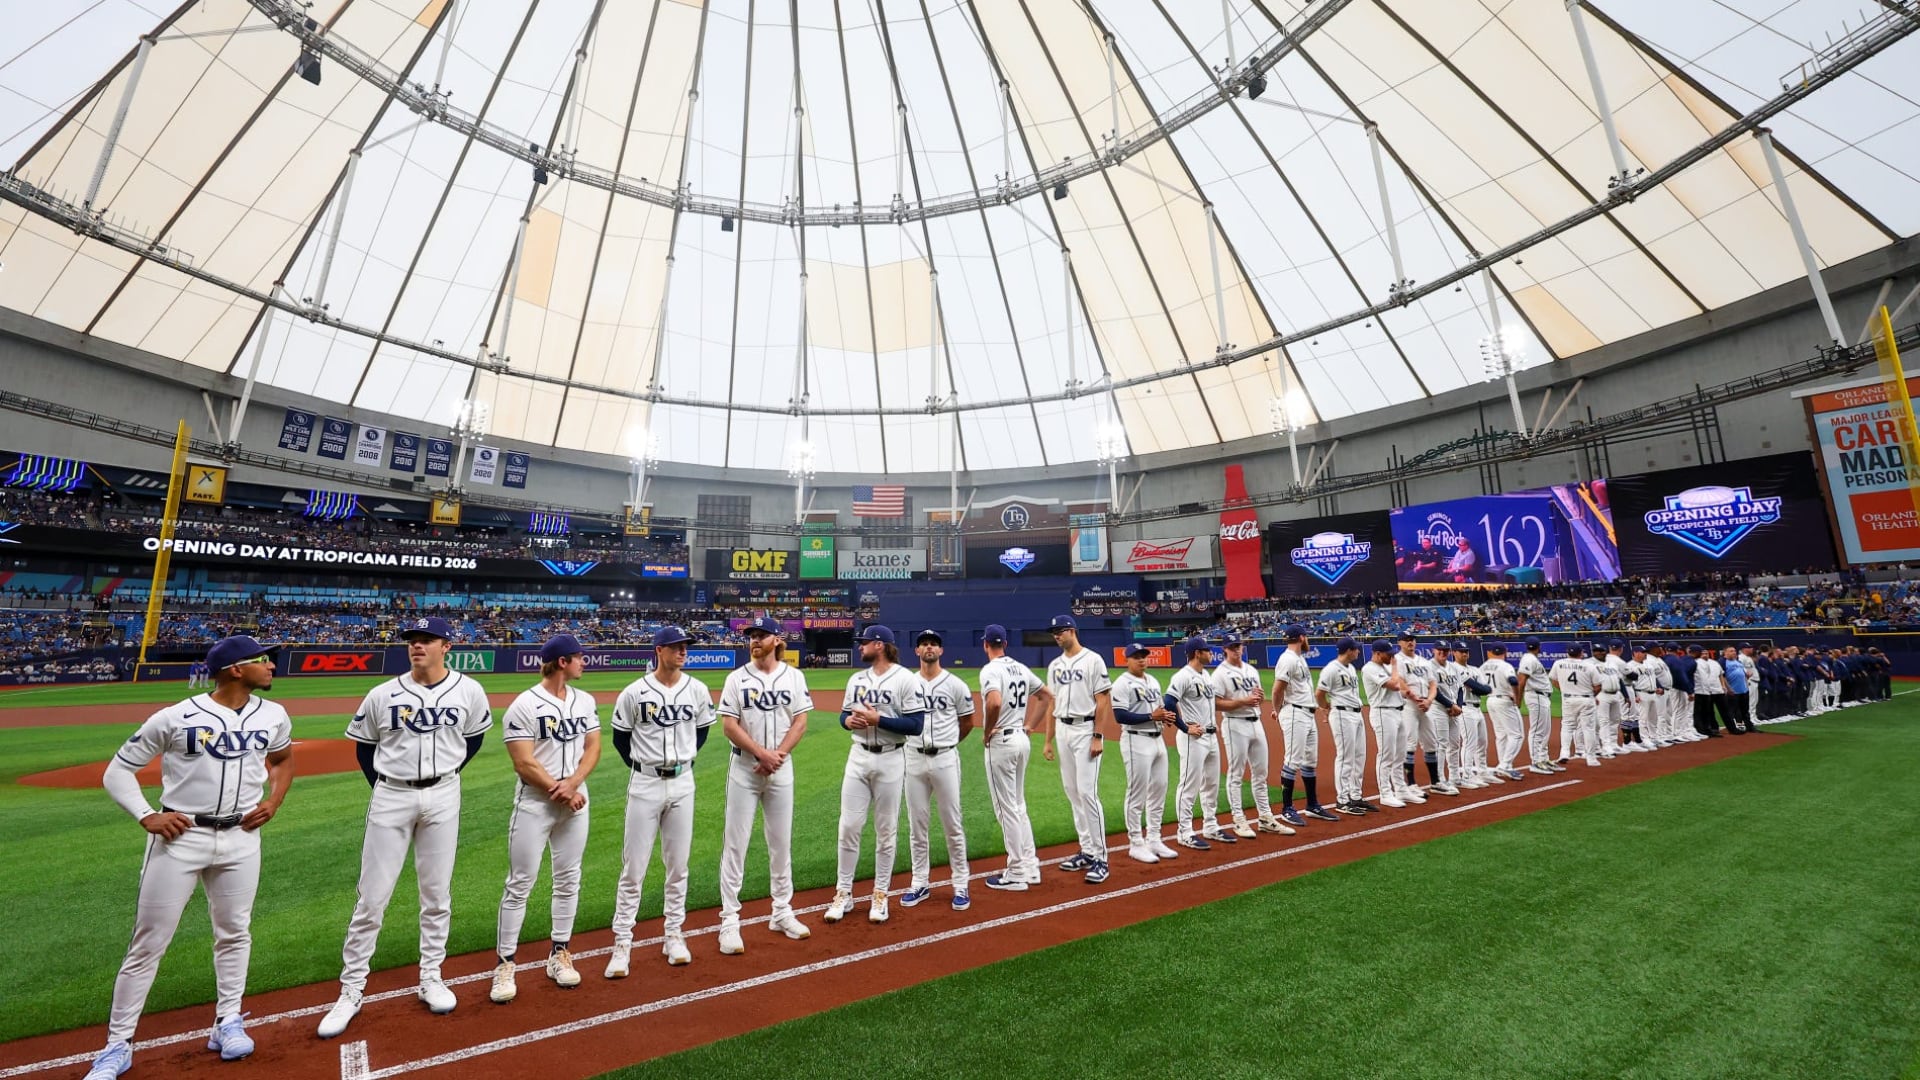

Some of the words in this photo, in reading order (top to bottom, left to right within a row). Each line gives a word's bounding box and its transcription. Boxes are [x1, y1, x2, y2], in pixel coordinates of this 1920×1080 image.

[1834, 385, 1897, 401] ORLANDO
[1843, 393, 1890, 407] HEALTH
[1830, 414, 1869, 427] MAJOR
[1871, 406, 1907, 421] LEAGU
[321, 442, 344, 453] 2008
[358, 449, 379, 460] 2008
[394, 456, 413, 466] 2010
[428, 462, 447, 471] 2020
[474, 468, 492, 478] 2020
[507, 475, 523, 483] 2021
[193, 492, 215, 500] FAST.
[1006, 509, 1025, 525] TB
[1427, 512, 1452, 524] SEMINOLE
[1648, 505, 1735, 524] OPENING
[1738, 500, 1777, 514] DAY
[1862, 511, 1919, 525] ORLAND
[1220, 520, 1260, 541] oca-Cola
[1666, 520, 1727, 531] TROPICANA
[1728, 516, 1759, 525] FIELD
[1478, 513, 1546, 567] 162
[1704, 528, 1723, 540] TB
[143, 537, 236, 555] OPENING
[240, 545, 278, 559] DAY
[278, 547, 301, 560] AT
[304, 549, 398, 565] TROPICANA
[401, 555, 442, 568] FIELD
[444, 558, 477, 569] 2026
[1132, 545, 1188, 557] Budweiser
[1293, 545, 1344, 559] OPENING
[1346, 544, 1369, 554] DAY
[732, 550, 788, 572] GMF
[1304, 556, 1339, 564] TROPICANA
[417, 618, 429, 629] TB
[301, 653, 374, 672] DEX
[582, 654, 610, 666] OME
[1006, 665, 1023, 677] MATZ
[1053, 668, 1083, 685] RAYS
[1567, 671, 1578, 685] 4
[1485, 672, 1497, 689] 71
[740, 687, 792, 712] RAYS
[1008, 680, 1026, 709] 32
[923, 695, 949, 711] AYS
[388, 704, 460, 734] RAYS
[638, 700, 694, 728] RAYS
[536, 714, 588, 744] RAYS
[182, 725, 270, 761] RAYS
